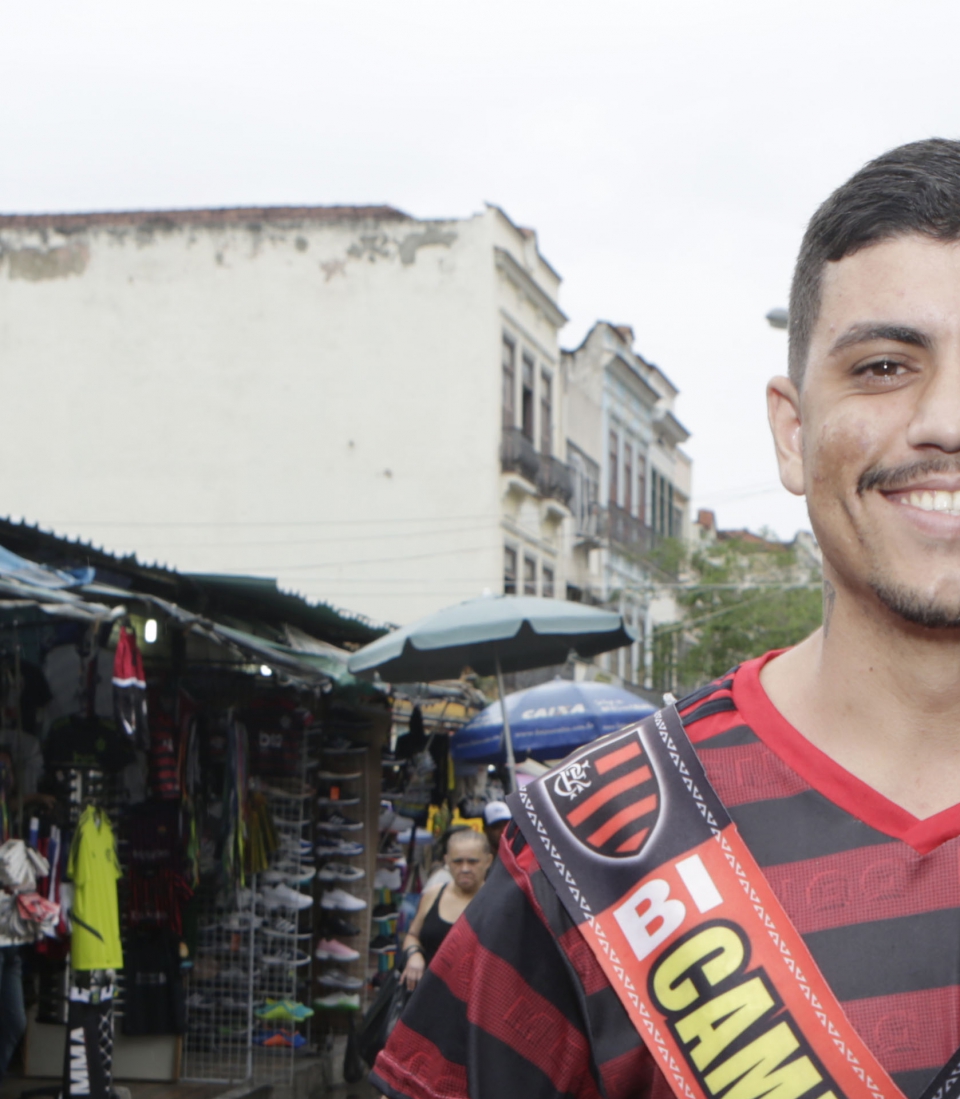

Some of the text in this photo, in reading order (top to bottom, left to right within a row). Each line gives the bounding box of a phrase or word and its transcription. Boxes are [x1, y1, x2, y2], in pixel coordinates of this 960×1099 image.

[522, 703, 586, 719] CAIXA
[614, 854, 724, 962] BI
[69, 1026, 91, 1096] MMA
